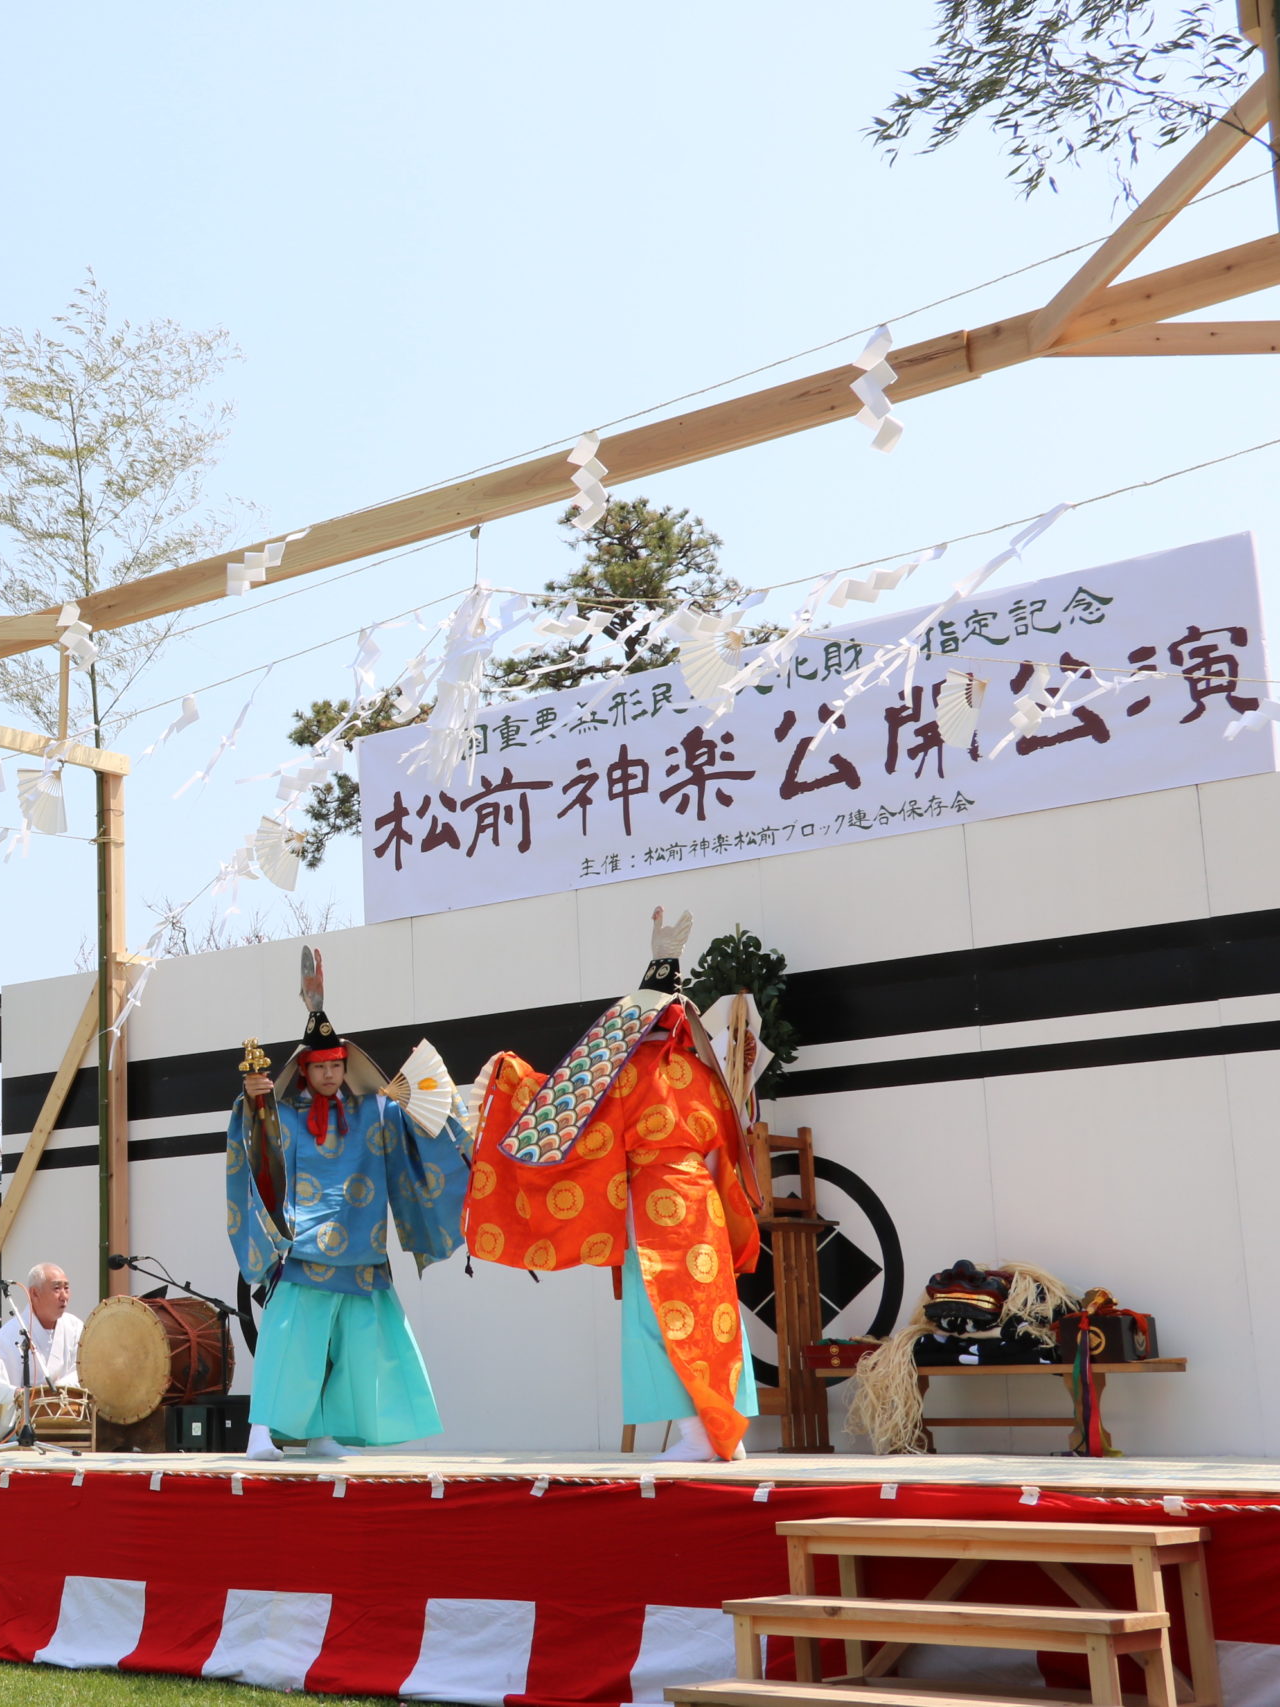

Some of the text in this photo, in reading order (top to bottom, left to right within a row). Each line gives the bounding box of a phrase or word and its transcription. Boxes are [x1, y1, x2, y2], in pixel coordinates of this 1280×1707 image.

[372, 625, 1260, 872] 松前神楽公開公演
[461, 586, 1114, 761] 国重要無形民化財 指定記念
